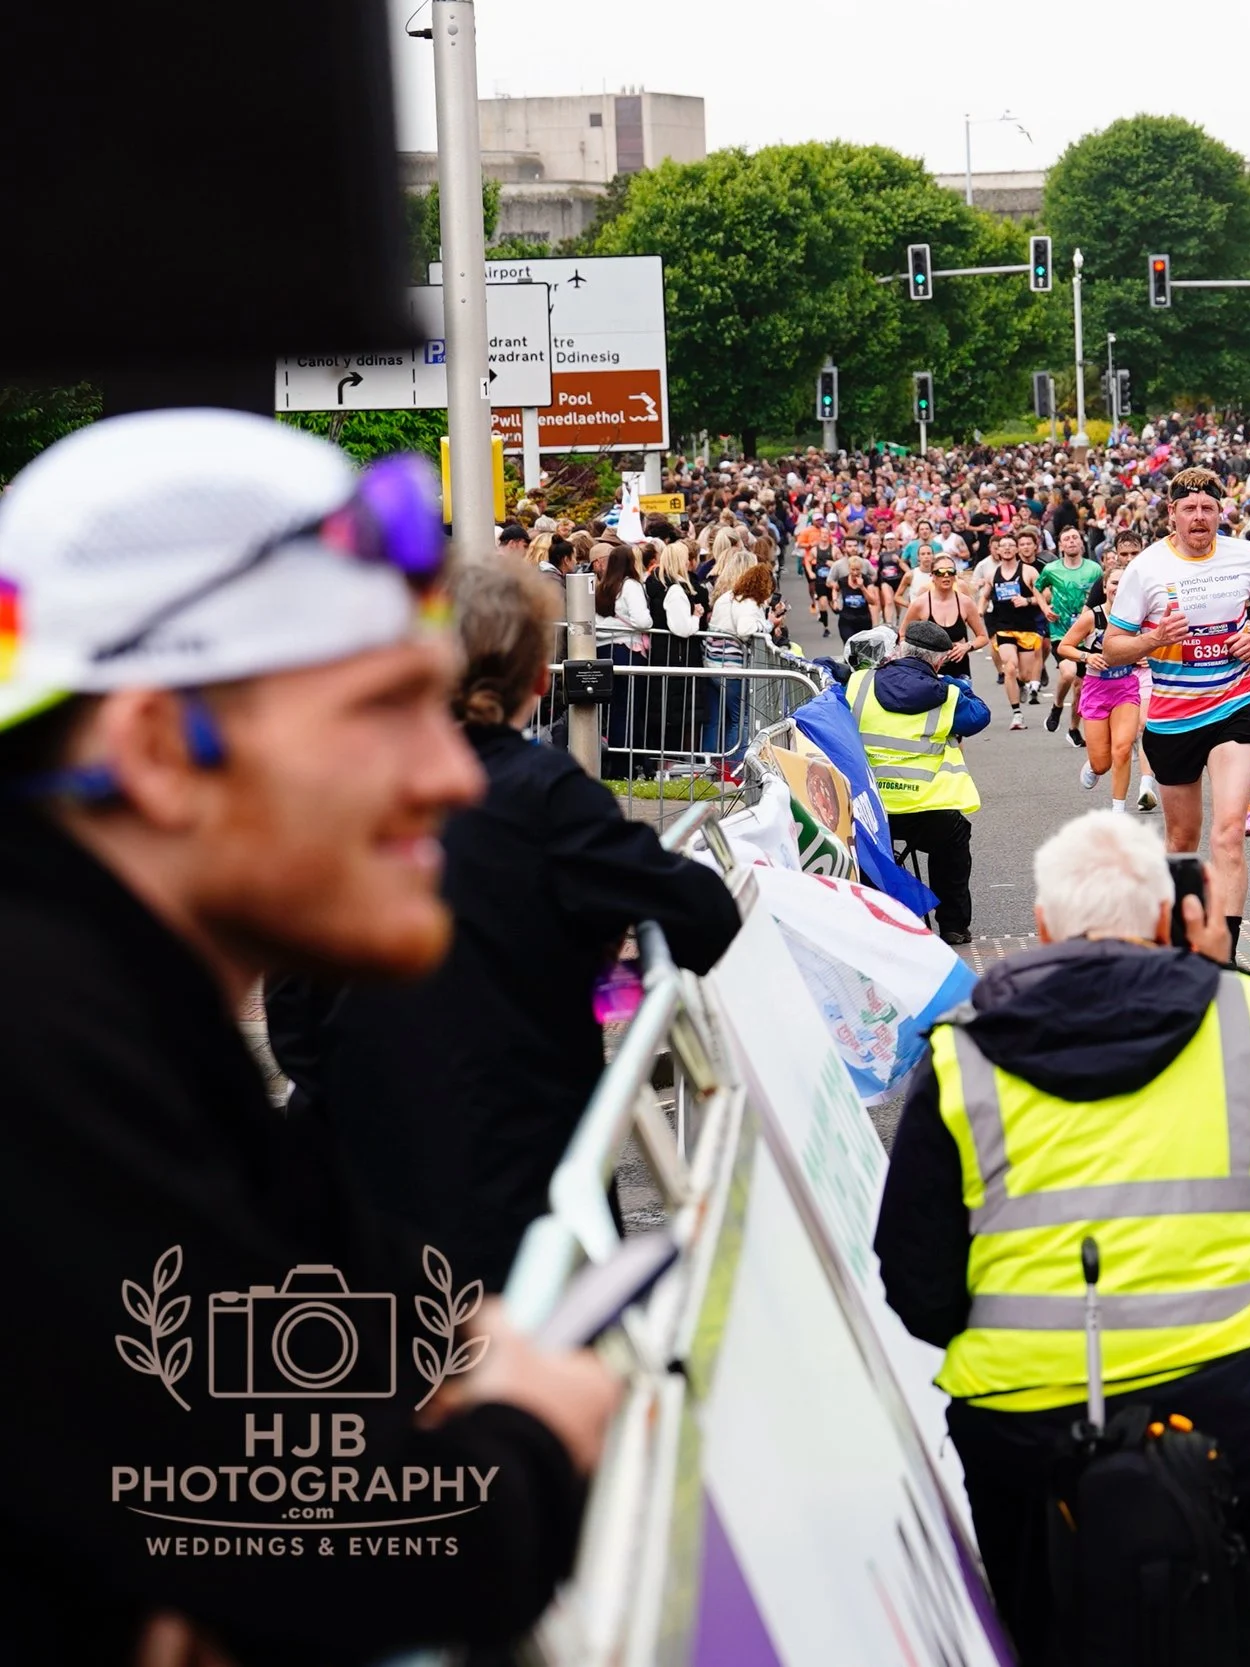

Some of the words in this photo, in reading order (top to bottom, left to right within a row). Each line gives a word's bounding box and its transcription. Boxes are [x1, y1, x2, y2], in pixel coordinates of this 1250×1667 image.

[485, 266, 531, 279] irport
[489, 336, 528, 347] drant
[554, 337, 575, 348] tre
[297, 355, 339, 367] Canol
[343, 359, 351, 368] y
[356, 354, 404, 366] ddinas
[488, 351, 544, 362] wadrant
[556, 350, 620, 364] Ddinesig
[559, 392, 593, 405] Pool
[491, 413, 522, 427] Pwll
[538, 411, 626, 426] enedlaethol
[1181, 586, 1207, 595] cymru
[1194, 644, 1229, 659] 6394
[877, 781, 920, 792] OTOGRAPHER
